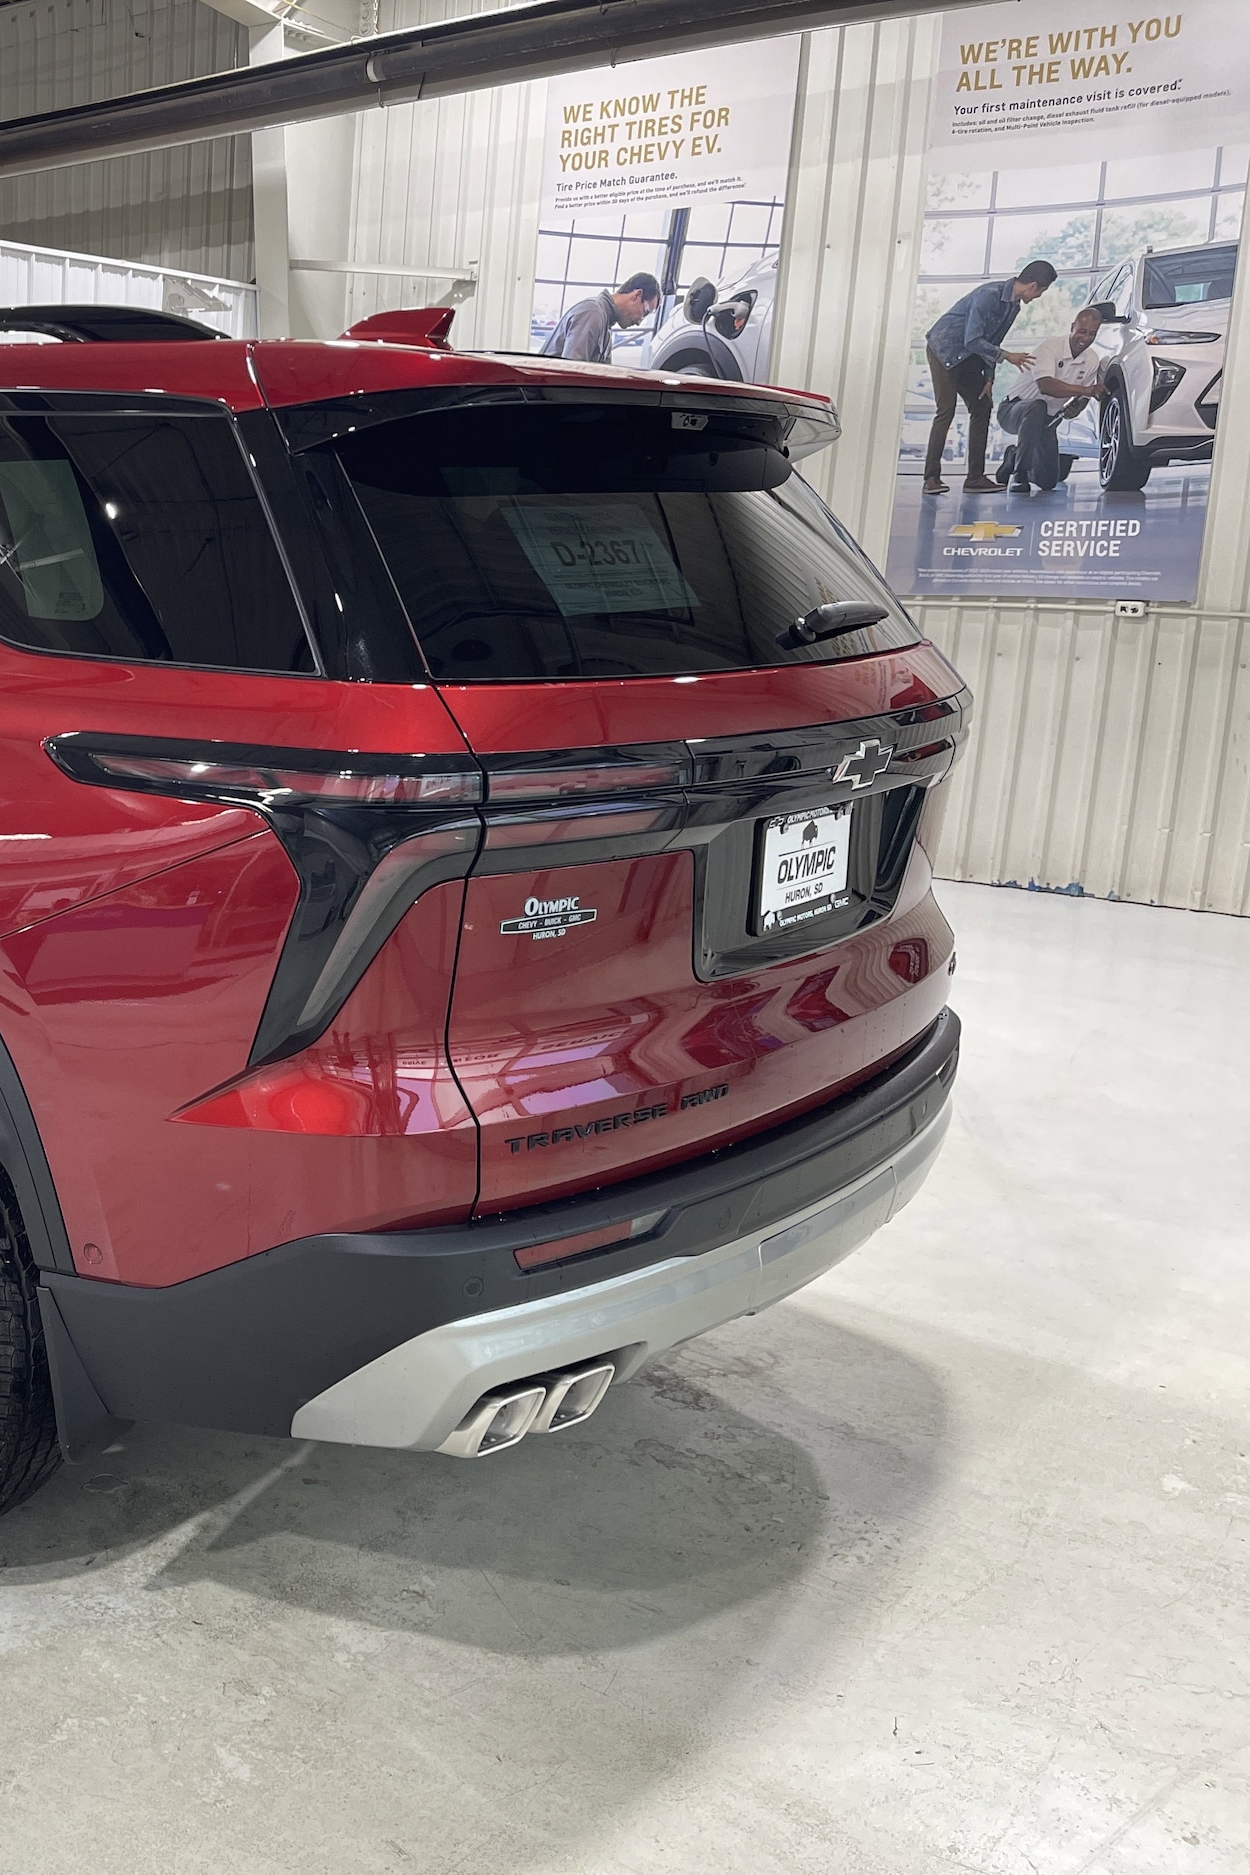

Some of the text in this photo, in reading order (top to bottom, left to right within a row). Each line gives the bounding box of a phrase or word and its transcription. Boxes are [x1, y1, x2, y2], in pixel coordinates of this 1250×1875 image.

[960, 14, 1182, 64] WE'RE WITH YOU
[956, 52, 1133, 92] ALL THE WAY.
[563, 85, 707, 124] WE KNOW THE
[954, 106, 978, 115] Your
[982, 102, 1005, 113] first
[1010, 95, 1082, 111] maintenance
[1086, 91, 1111, 102] visit
[1115, 89, 1124, 98] is
[561, 108, 730, 148] RIGHT TIRES FOR
[1006, 122, 1038, 130] Multi-Point
[559, 134, 722, 172] YOUR CHEVY EV.
[557, 172, 678, 192] Tire Price Match Guarantee.
[1040, 520, 1141, 537] CERTIFIED
[551, 540, 640, 566] D-2367
[943, 548, 1023, 556] CHEVROLET
[1038, 541, 1121, 556] SERVICE
[778, 846, 836, 884] OLYMPIC
[785, 882, 823, 904] HURON, SD
[834, 897, 849, 908] GMC
[525, 897, 579, 916] OLYMPIC
[518, 922, 538, 930] CHEVY
[544, 917, 562, 926] BUICK
[569, 914, 582, 922] GMC
[533, 928, 566, 940] HURON, SD
[505, 1083, 729, 1154] TRAVERSE AWD
